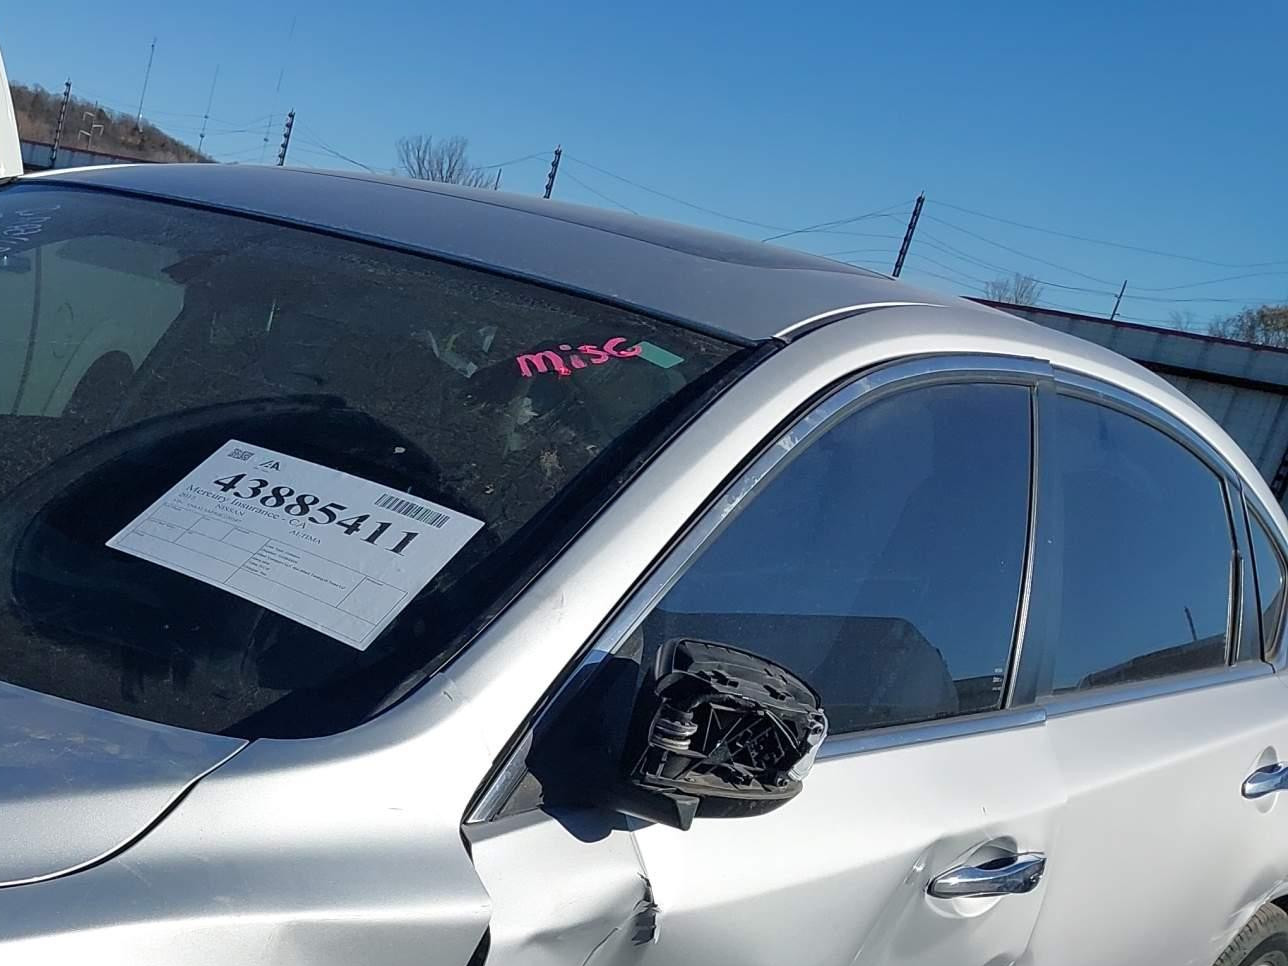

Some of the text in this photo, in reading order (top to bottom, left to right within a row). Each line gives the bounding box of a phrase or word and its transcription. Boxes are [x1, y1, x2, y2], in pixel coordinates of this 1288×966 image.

[186, 484, 227, 504] Mercury
[230, 498, 280, 520] Insurance
[288, 518, 307, 529] CA
[213, 472, 420, 557] 43885411
[288, 529, 322, 545] ALTIMA
